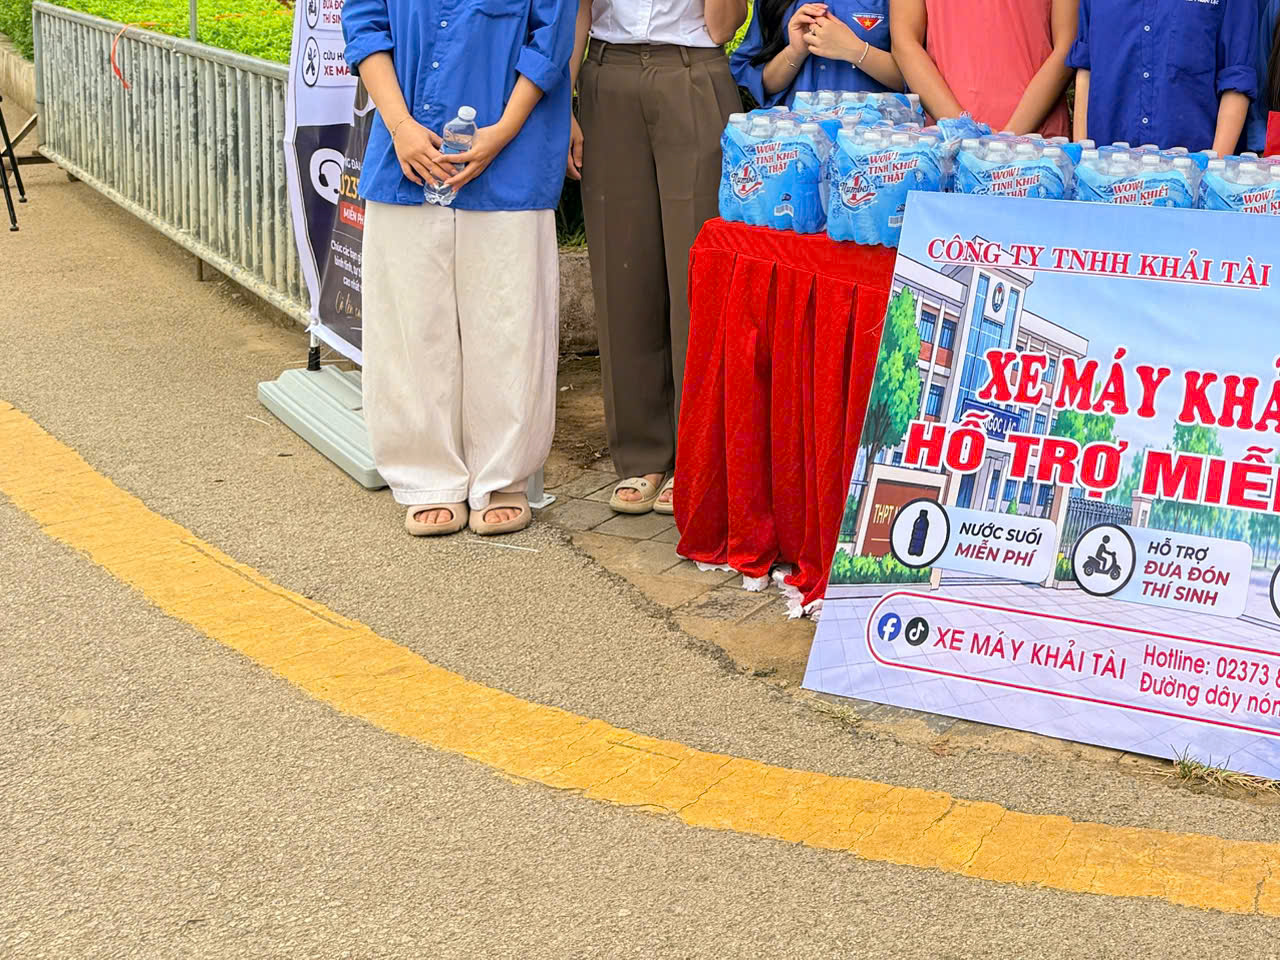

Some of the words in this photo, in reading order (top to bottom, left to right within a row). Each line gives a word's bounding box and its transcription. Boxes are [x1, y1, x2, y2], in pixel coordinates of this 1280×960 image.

[324, 65, 335, 75] XE
[756, 142, 781, 154] WOW!
[870, 152, 899, 164] WOW!
[756, 155, 774, 165] TINH
[869, 164, 889, 175] TINH
[992, 167, 1020, 181] WOW!
[992, 181, 1013, 192] TINH
[1113, 180, 1144, 194] WOW!
[1114, 194, 1137, 205] TINH
[1140, 184, 1168, 201] KHIẾT
[1243, 189, 1275, 204] WOW!
[1243, 204, 1266, 214] TINH
[928, 234, 1002, 264] CÔNG
[1010, 244, 1045, 267] TY
[1052, 247, 1132, 275] TNHH
[1137, 250, 1212, 283] KHẢI
[1221, 255, 1272, 287] TÀI
[979, 351, 1047, 404] XE
[1055, 348, 1171, 418] MÁY
[984, 417, 1003, 435] GỌC
[904, 412, 989, 471] HỖ
[1007, 434, 1129, 499] TRỢ
[872, 504, 895, 525] THPT
[959, 521, 1004, 540] NƯỚC
[1006, 527, 1043, 546] SUỐI
[954, 538, 1001, 563] MIỄN
[1002, 548, 1037, 568] PHÍ
[1147, 537, 1173, 557] HỖ
[1176, 544, 1209, 562] TRỢ
[1144, 559, 1184, 582] ĐƯA
[1187, 565, 1230, 587] ĐÓN
[1141, 579, 1173, 601] THÍ
[1174, 586, 1218, 607] SINH
[934, 626, 965, 651] XE
[969, 631, 1024, 662] MÁY
[1030, 640, 1085, 673] KHẢI
[1092, 650, 1127, 680] TÀI
[1144, 644, 1211, 675] Hotline:
[1216, 657, 1270, 686] 02373
[1139, 671, 1200, 708] Đường
[1205, 686, 1242, 714] dây
